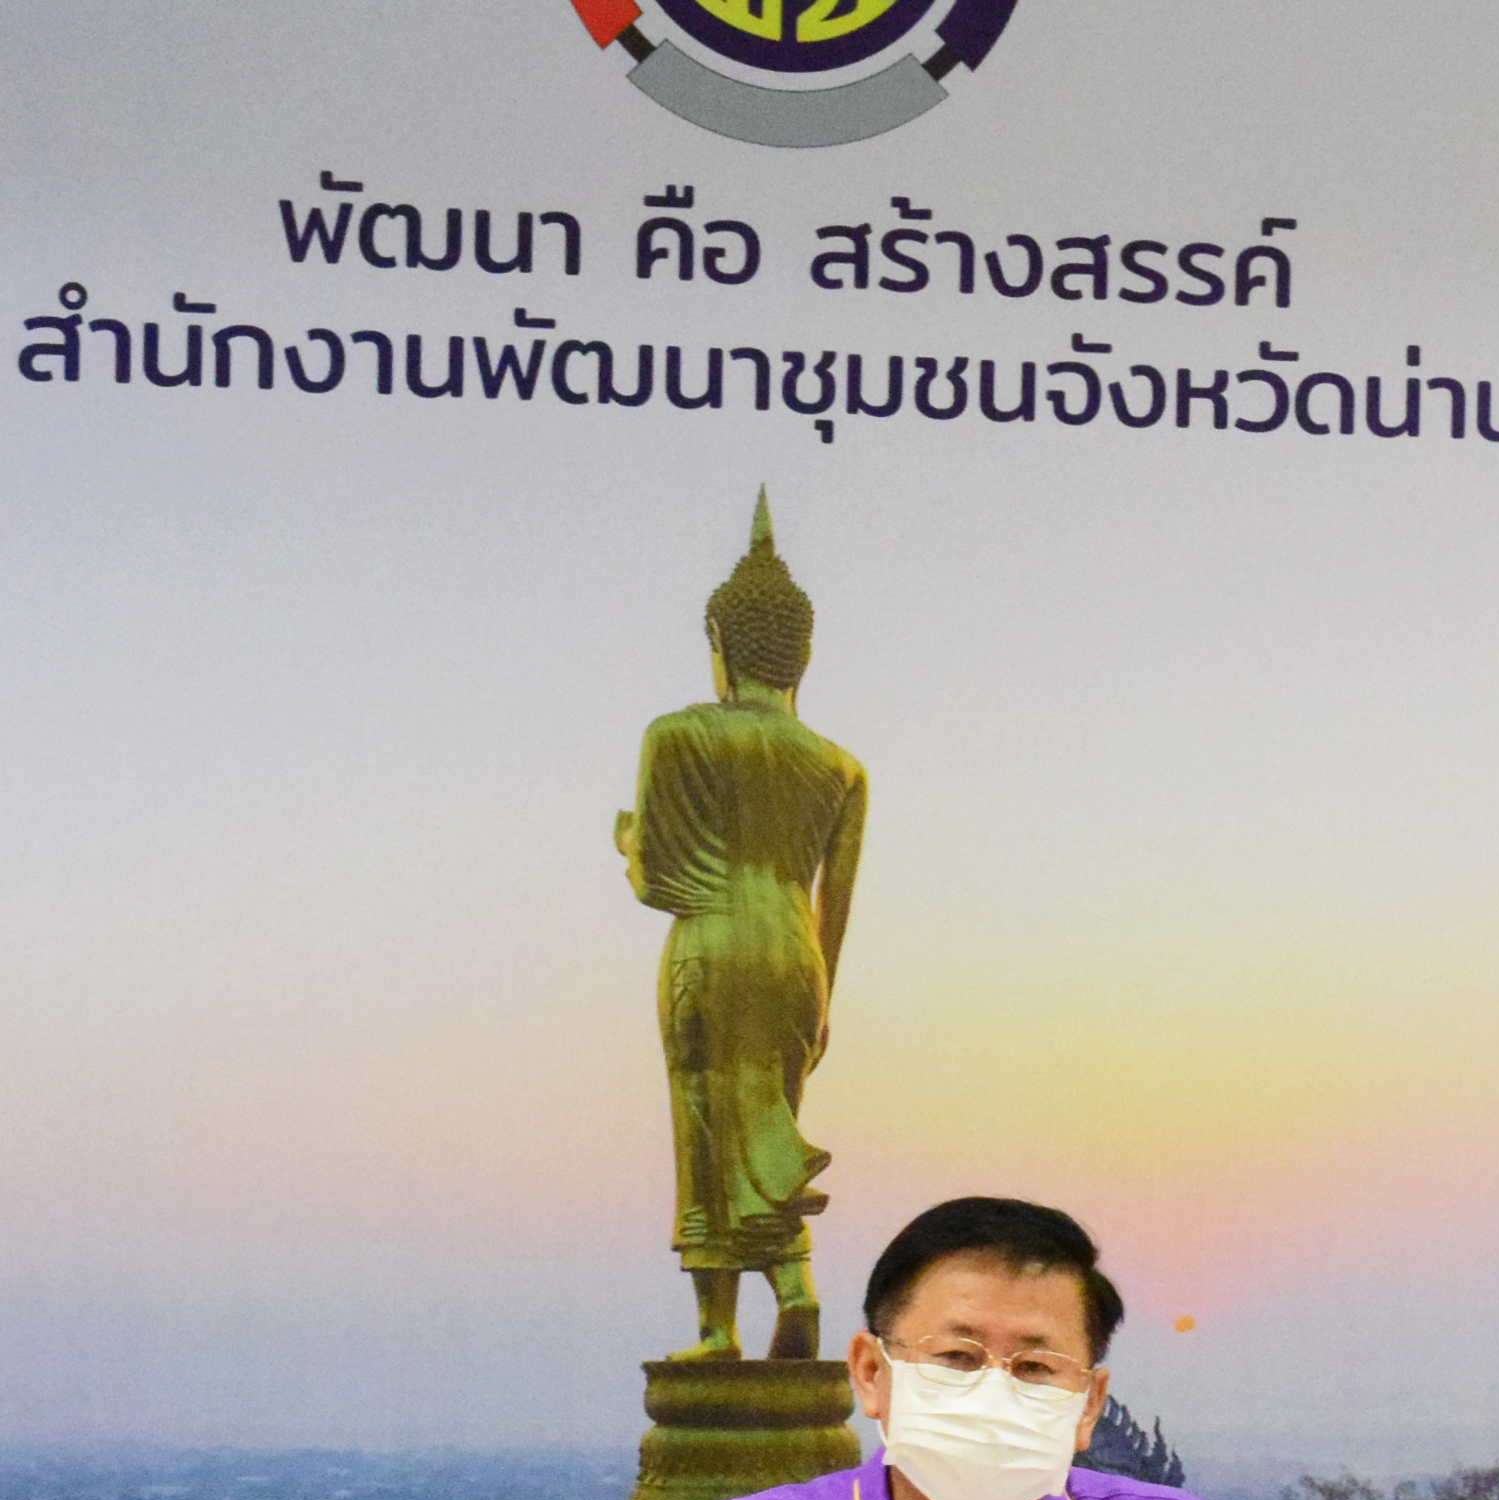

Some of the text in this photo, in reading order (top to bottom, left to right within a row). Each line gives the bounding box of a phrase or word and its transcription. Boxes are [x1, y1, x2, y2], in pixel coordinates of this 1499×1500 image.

[278, 170, 1298, 309] พัฒนา คือ สร้างสรรค์
